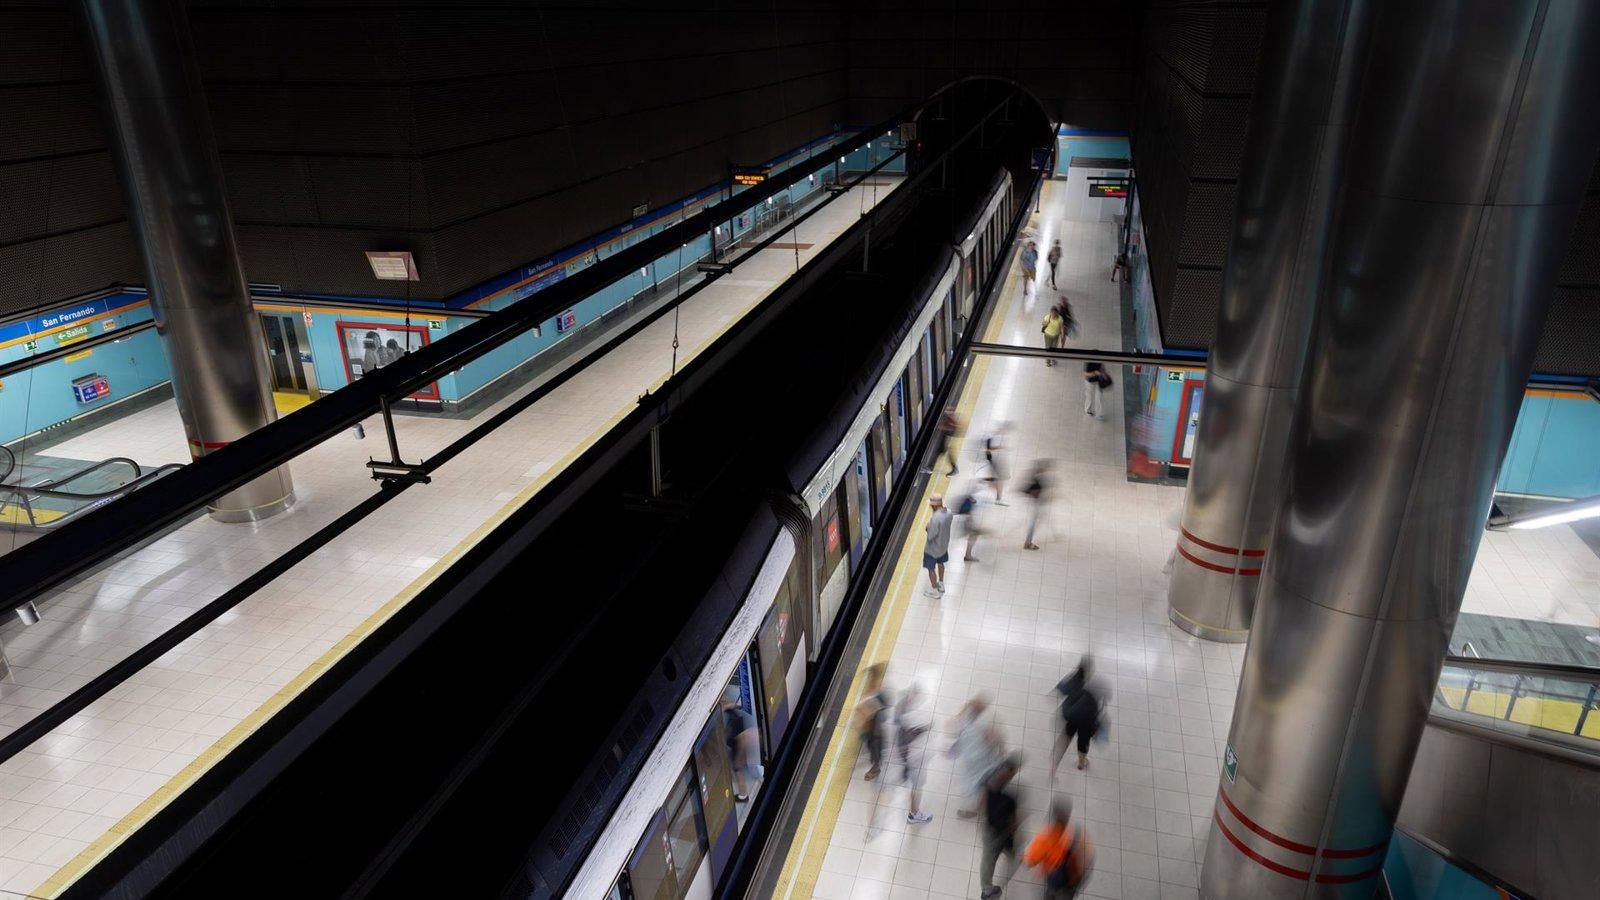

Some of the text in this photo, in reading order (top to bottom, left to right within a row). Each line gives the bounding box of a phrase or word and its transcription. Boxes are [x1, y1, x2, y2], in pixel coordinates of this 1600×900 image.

[42, 318, 58, 327] San
[59, 307, 95, 321] Fernando
[66, 326, 88, 338] Salida
